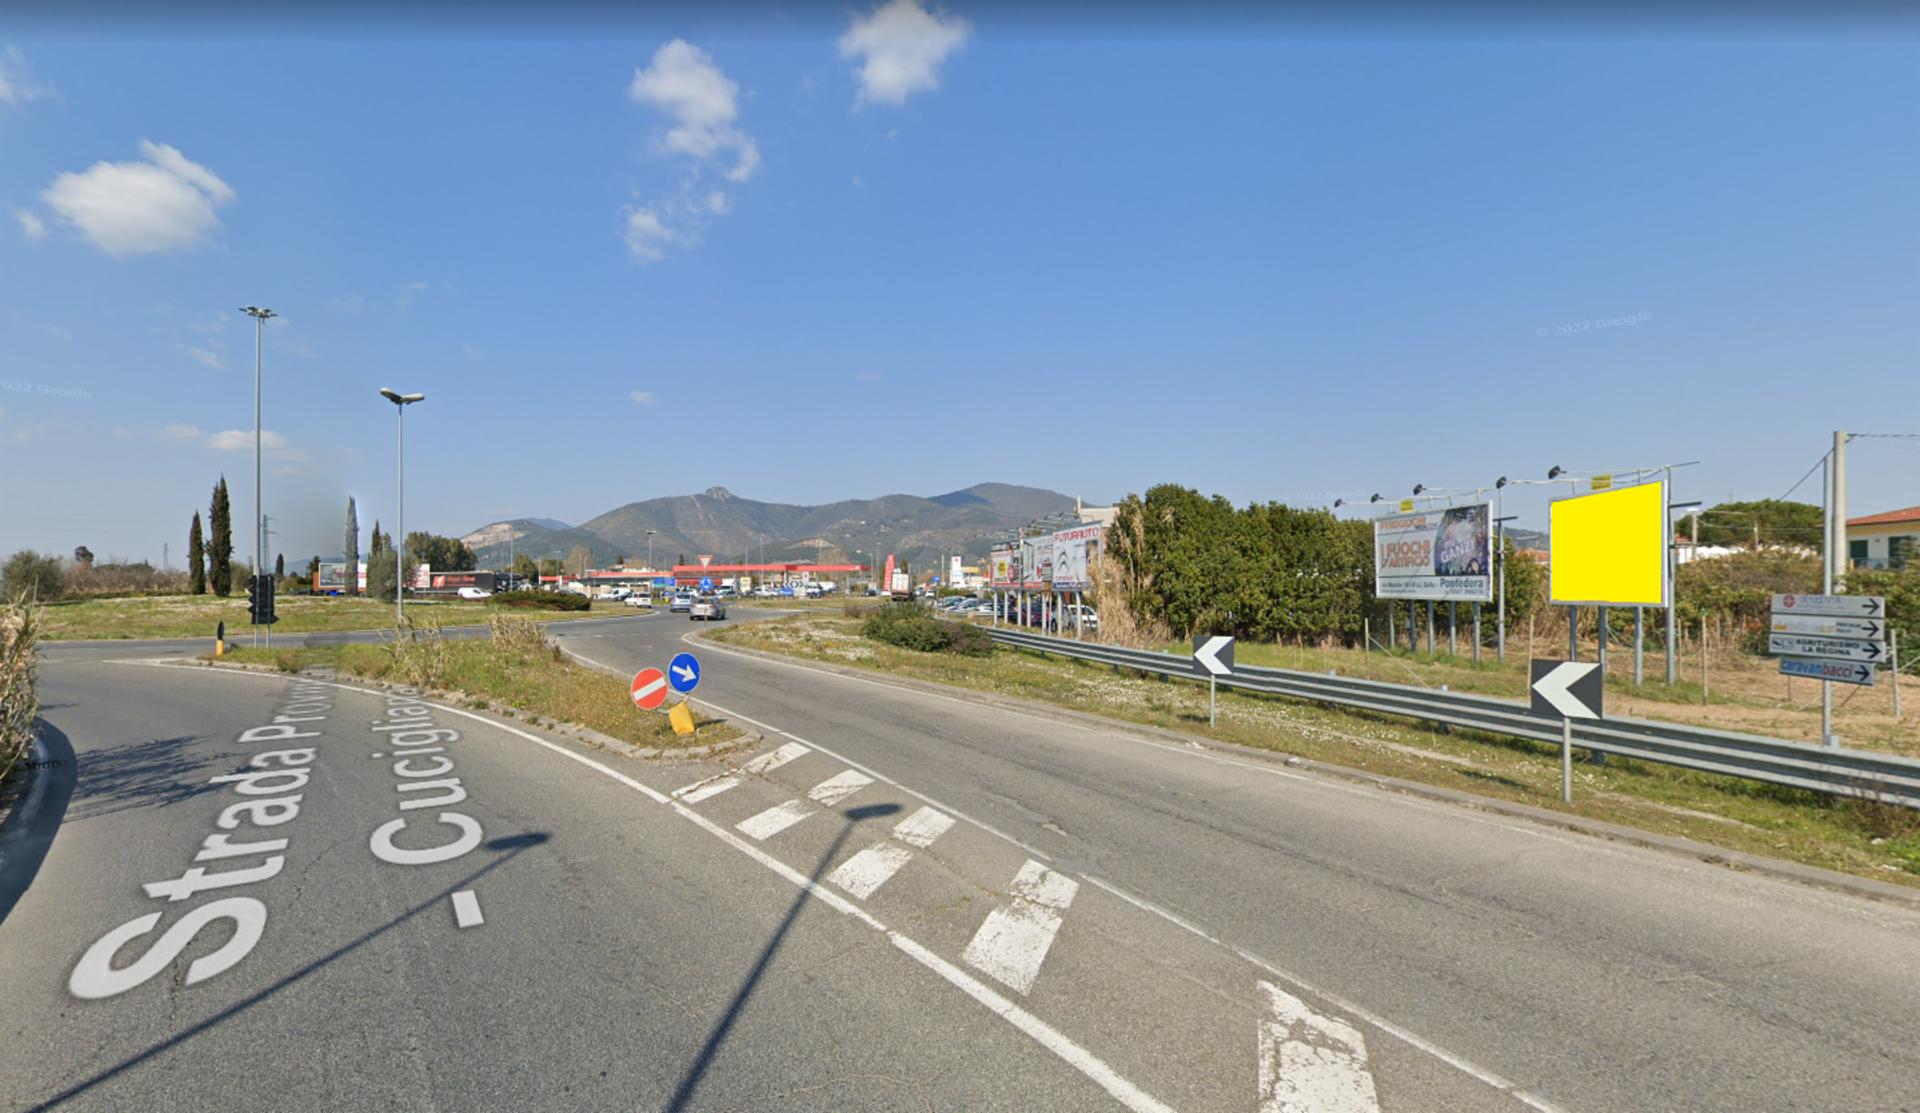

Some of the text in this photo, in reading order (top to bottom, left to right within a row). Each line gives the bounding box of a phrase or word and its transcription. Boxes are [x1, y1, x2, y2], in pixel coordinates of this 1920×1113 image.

[1387, 540, 1430, 557] FUOCHI
[1440, 578, 1484, 589] Pontedera
[1795, 638, 1860, 650] AGRITURISMO
[1816, 647, 1852, 656] REGINA
